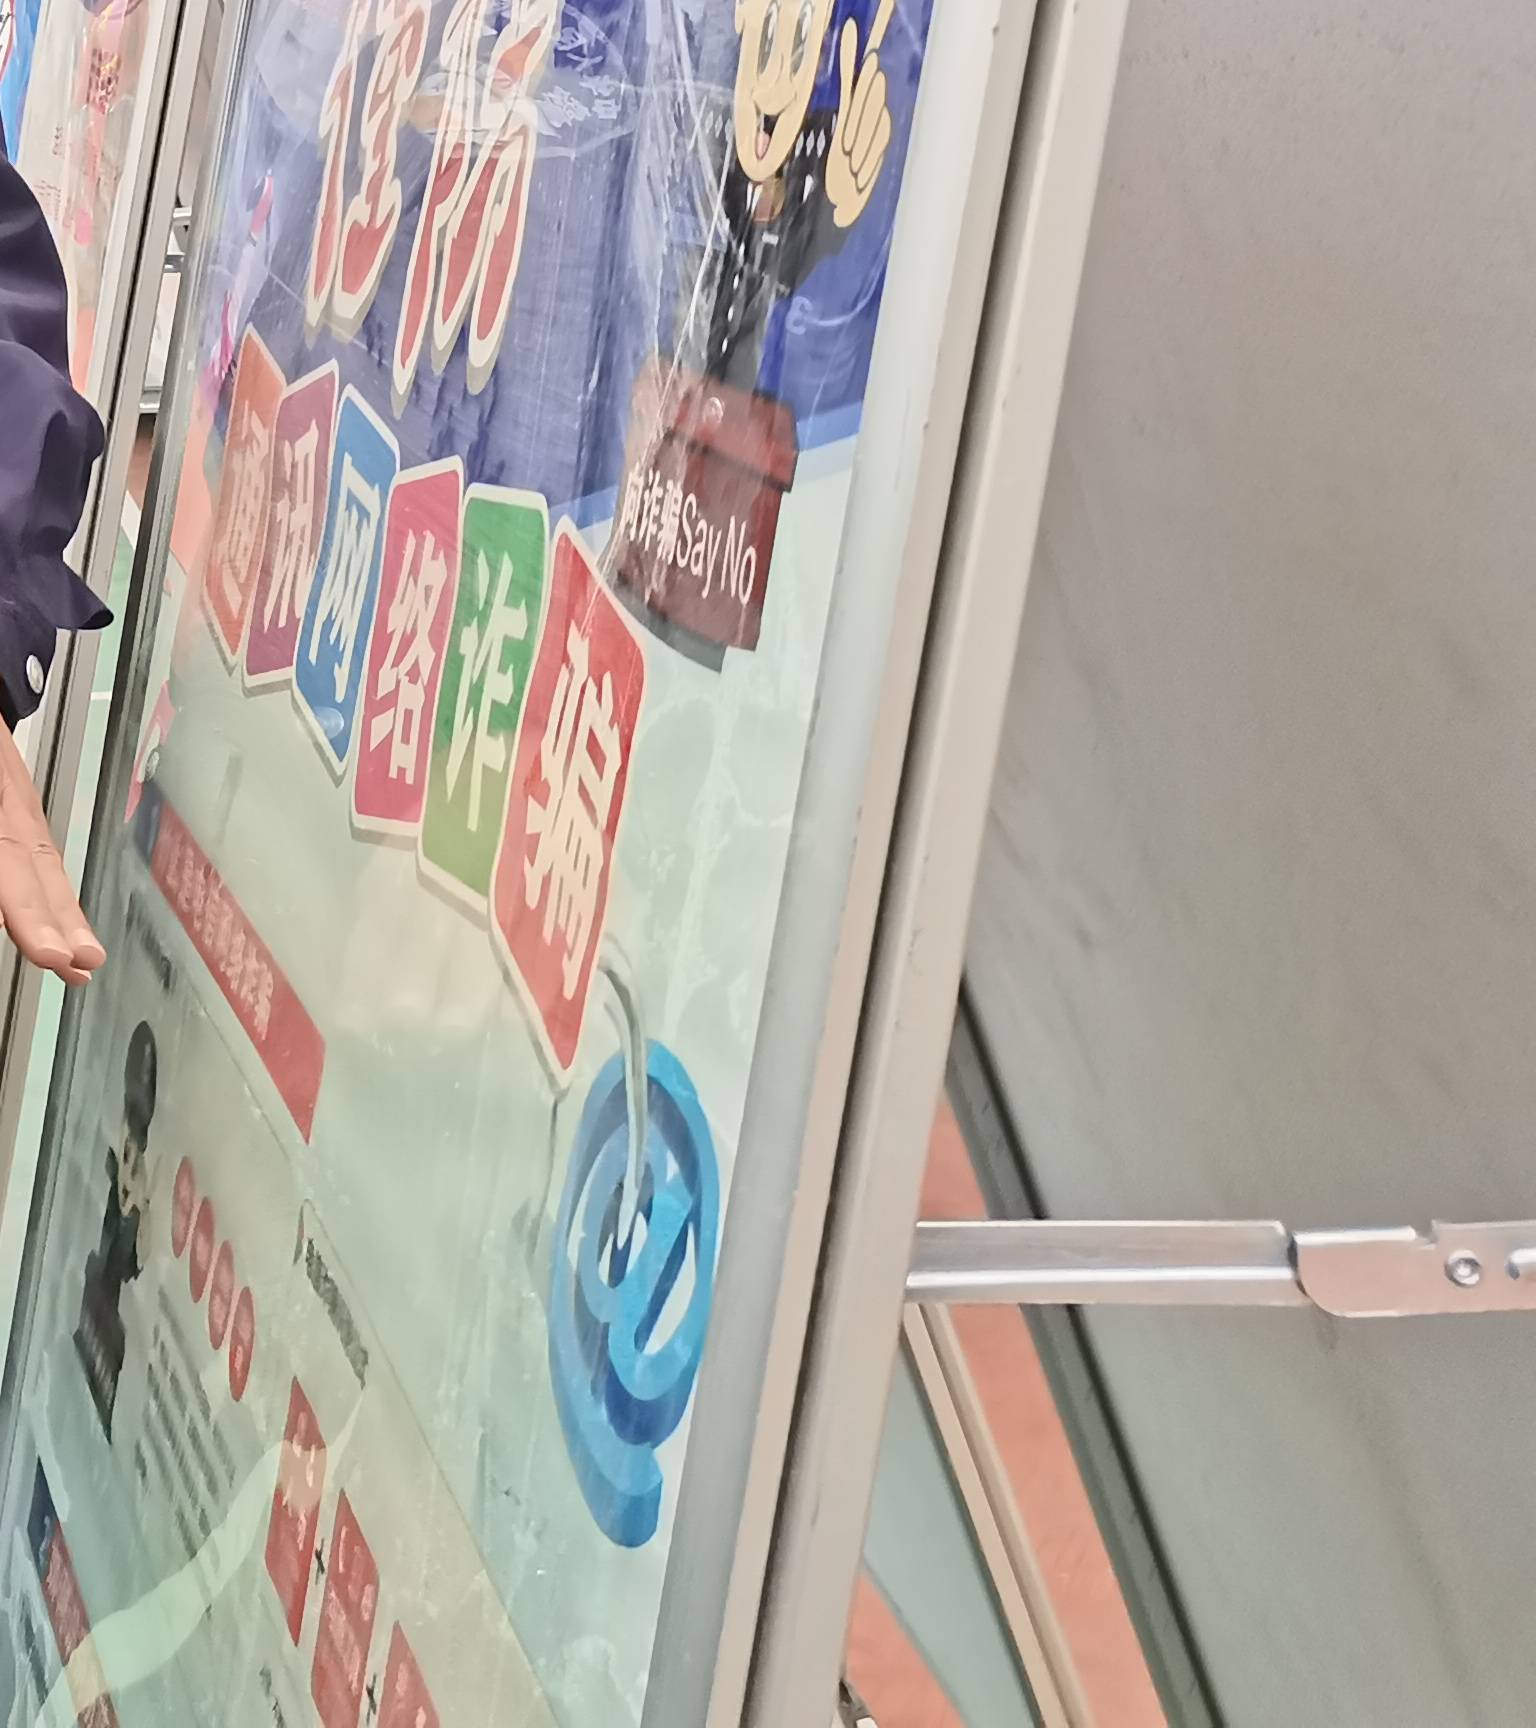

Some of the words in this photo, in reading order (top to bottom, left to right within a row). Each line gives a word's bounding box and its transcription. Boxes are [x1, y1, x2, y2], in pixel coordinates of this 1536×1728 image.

[227, 406, 623, 1001] 通讯网络诈骗
[721, 515, 757, 605] No
